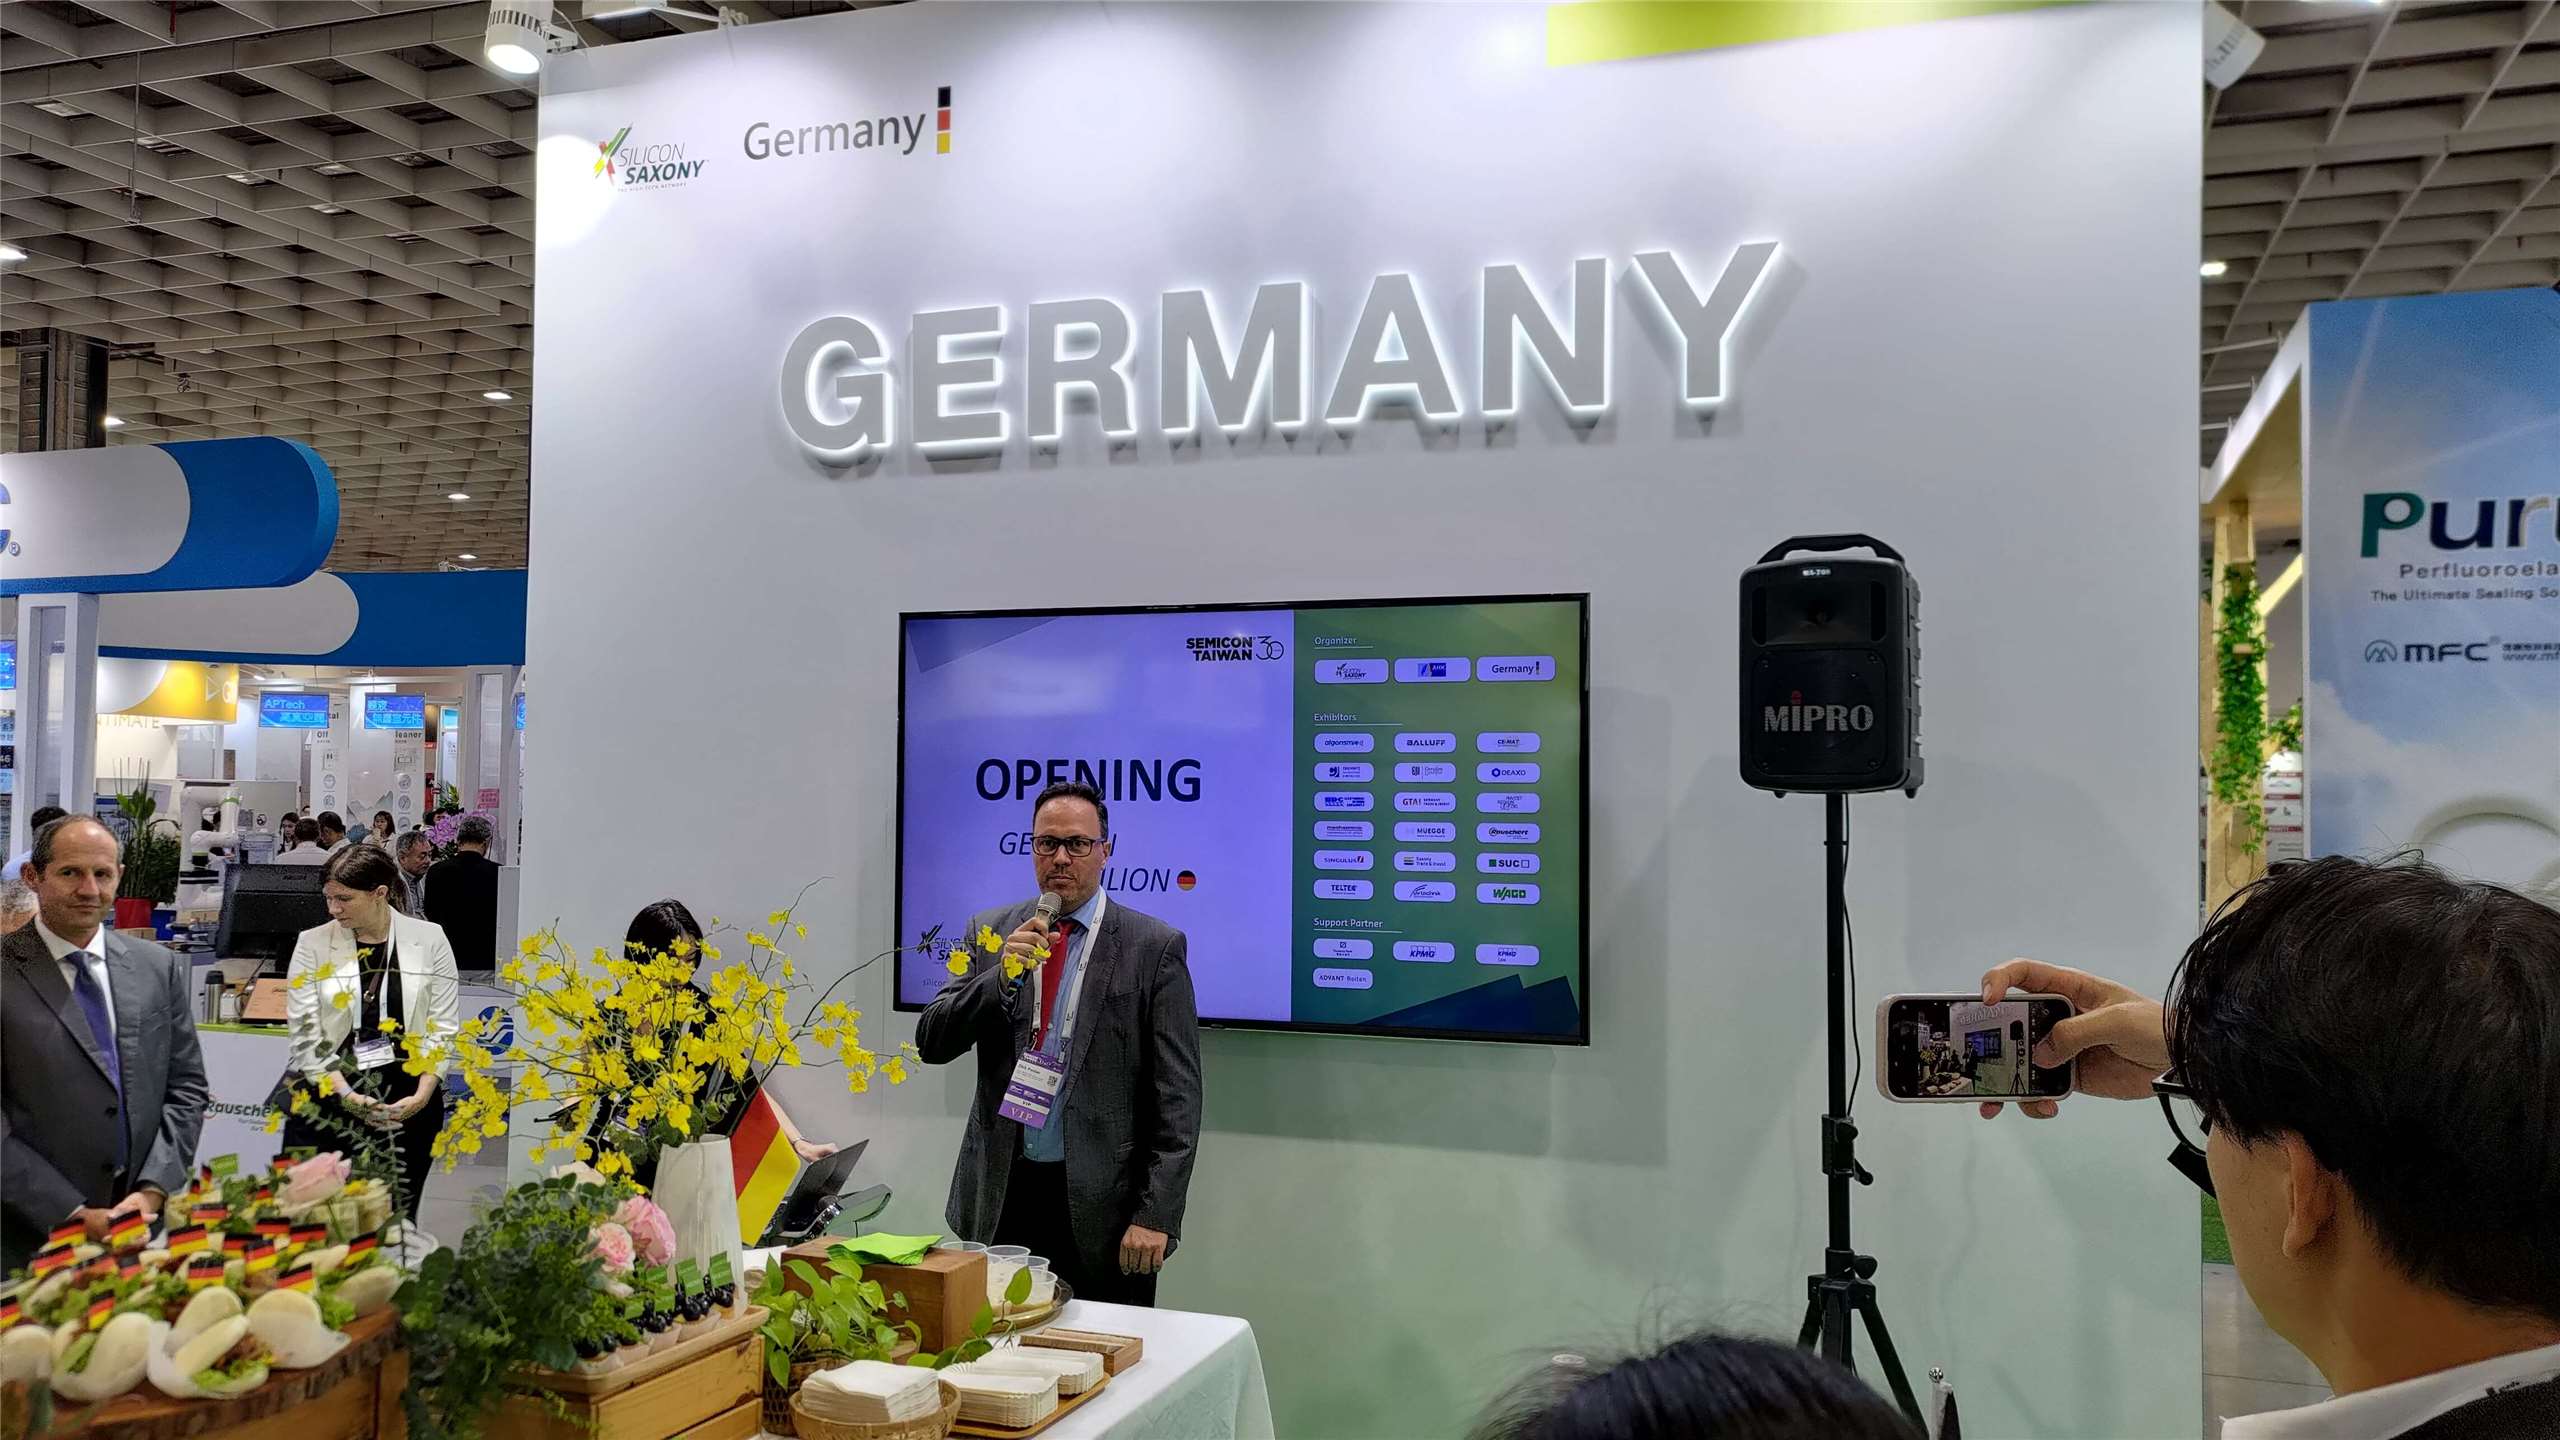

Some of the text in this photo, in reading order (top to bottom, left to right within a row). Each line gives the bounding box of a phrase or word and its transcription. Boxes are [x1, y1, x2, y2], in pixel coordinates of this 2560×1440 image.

[743, 113, 926, 161] Germany
[618, 143, 686, 168] SILICON
[624, 160, 705, 185] SAXONY
[779, 241, 1781, 456] GERMANY
[2371, 589, 2397, 601] The
[2404, 588, 2470, 601] Ultimate
[2475, 588, 2534, 600] Sealing
[1186, 637, 1253, 649] SEMICON
[1314, 636, 1357, 647] Organizer
[1193, 649, 1253, 661] TAIWAN
[1491, 663, 1534, 675] Germany
[1314, 713, 1357, 722] Exhibitors
[1407, 739, 1446, 747] BALLUFF
[976, 758, 1202, 802] OPENING
[1100, 868, 1171, 892] ILION
[1313, 918, 1383, 928] Support Partner
[1410, 949, 1436, 958] KPMG
[208, 1101, 273, 1117] Rausche
